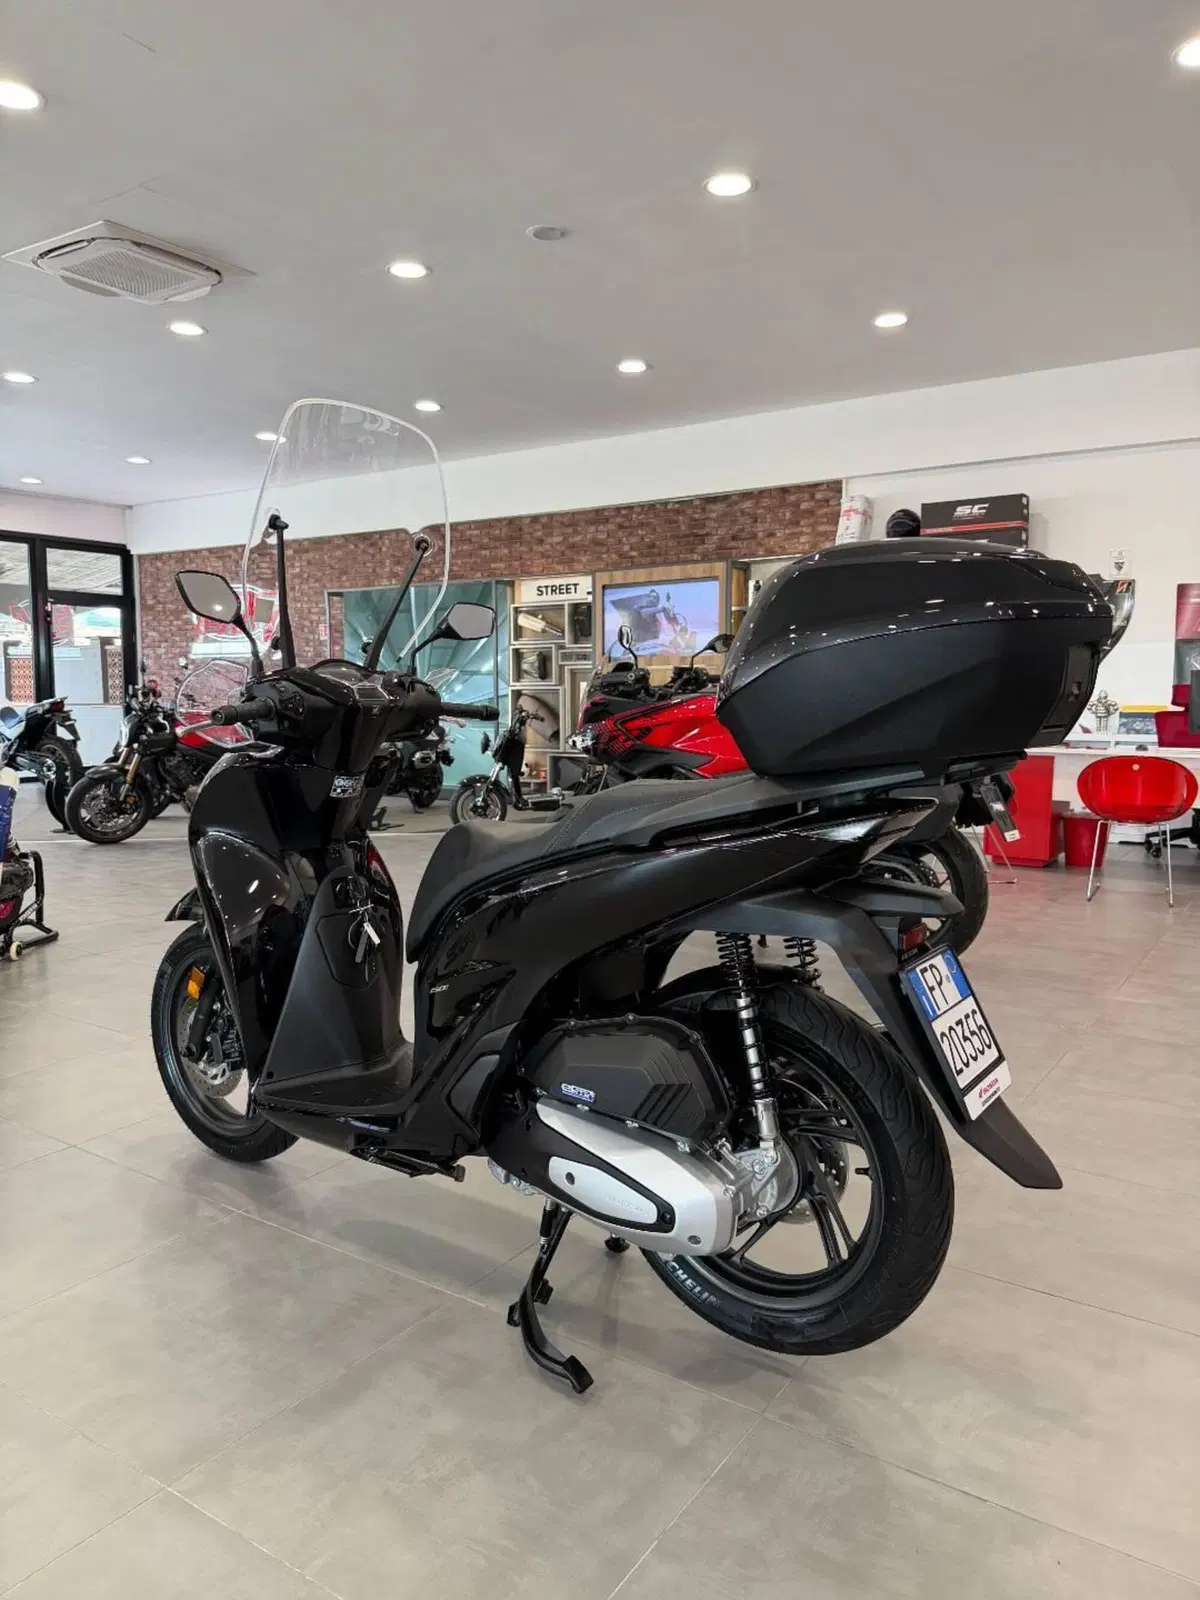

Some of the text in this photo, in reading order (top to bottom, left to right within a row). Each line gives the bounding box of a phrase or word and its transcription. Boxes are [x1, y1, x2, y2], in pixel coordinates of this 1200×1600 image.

[953, 503, 990, 516] SC
[536, 582, 580, 597] STREET
[919, 963, 949, 1011] FP
[939, 1008, 992, 1076] 20356
[666, 1261, 721, 1308] CHELIN
